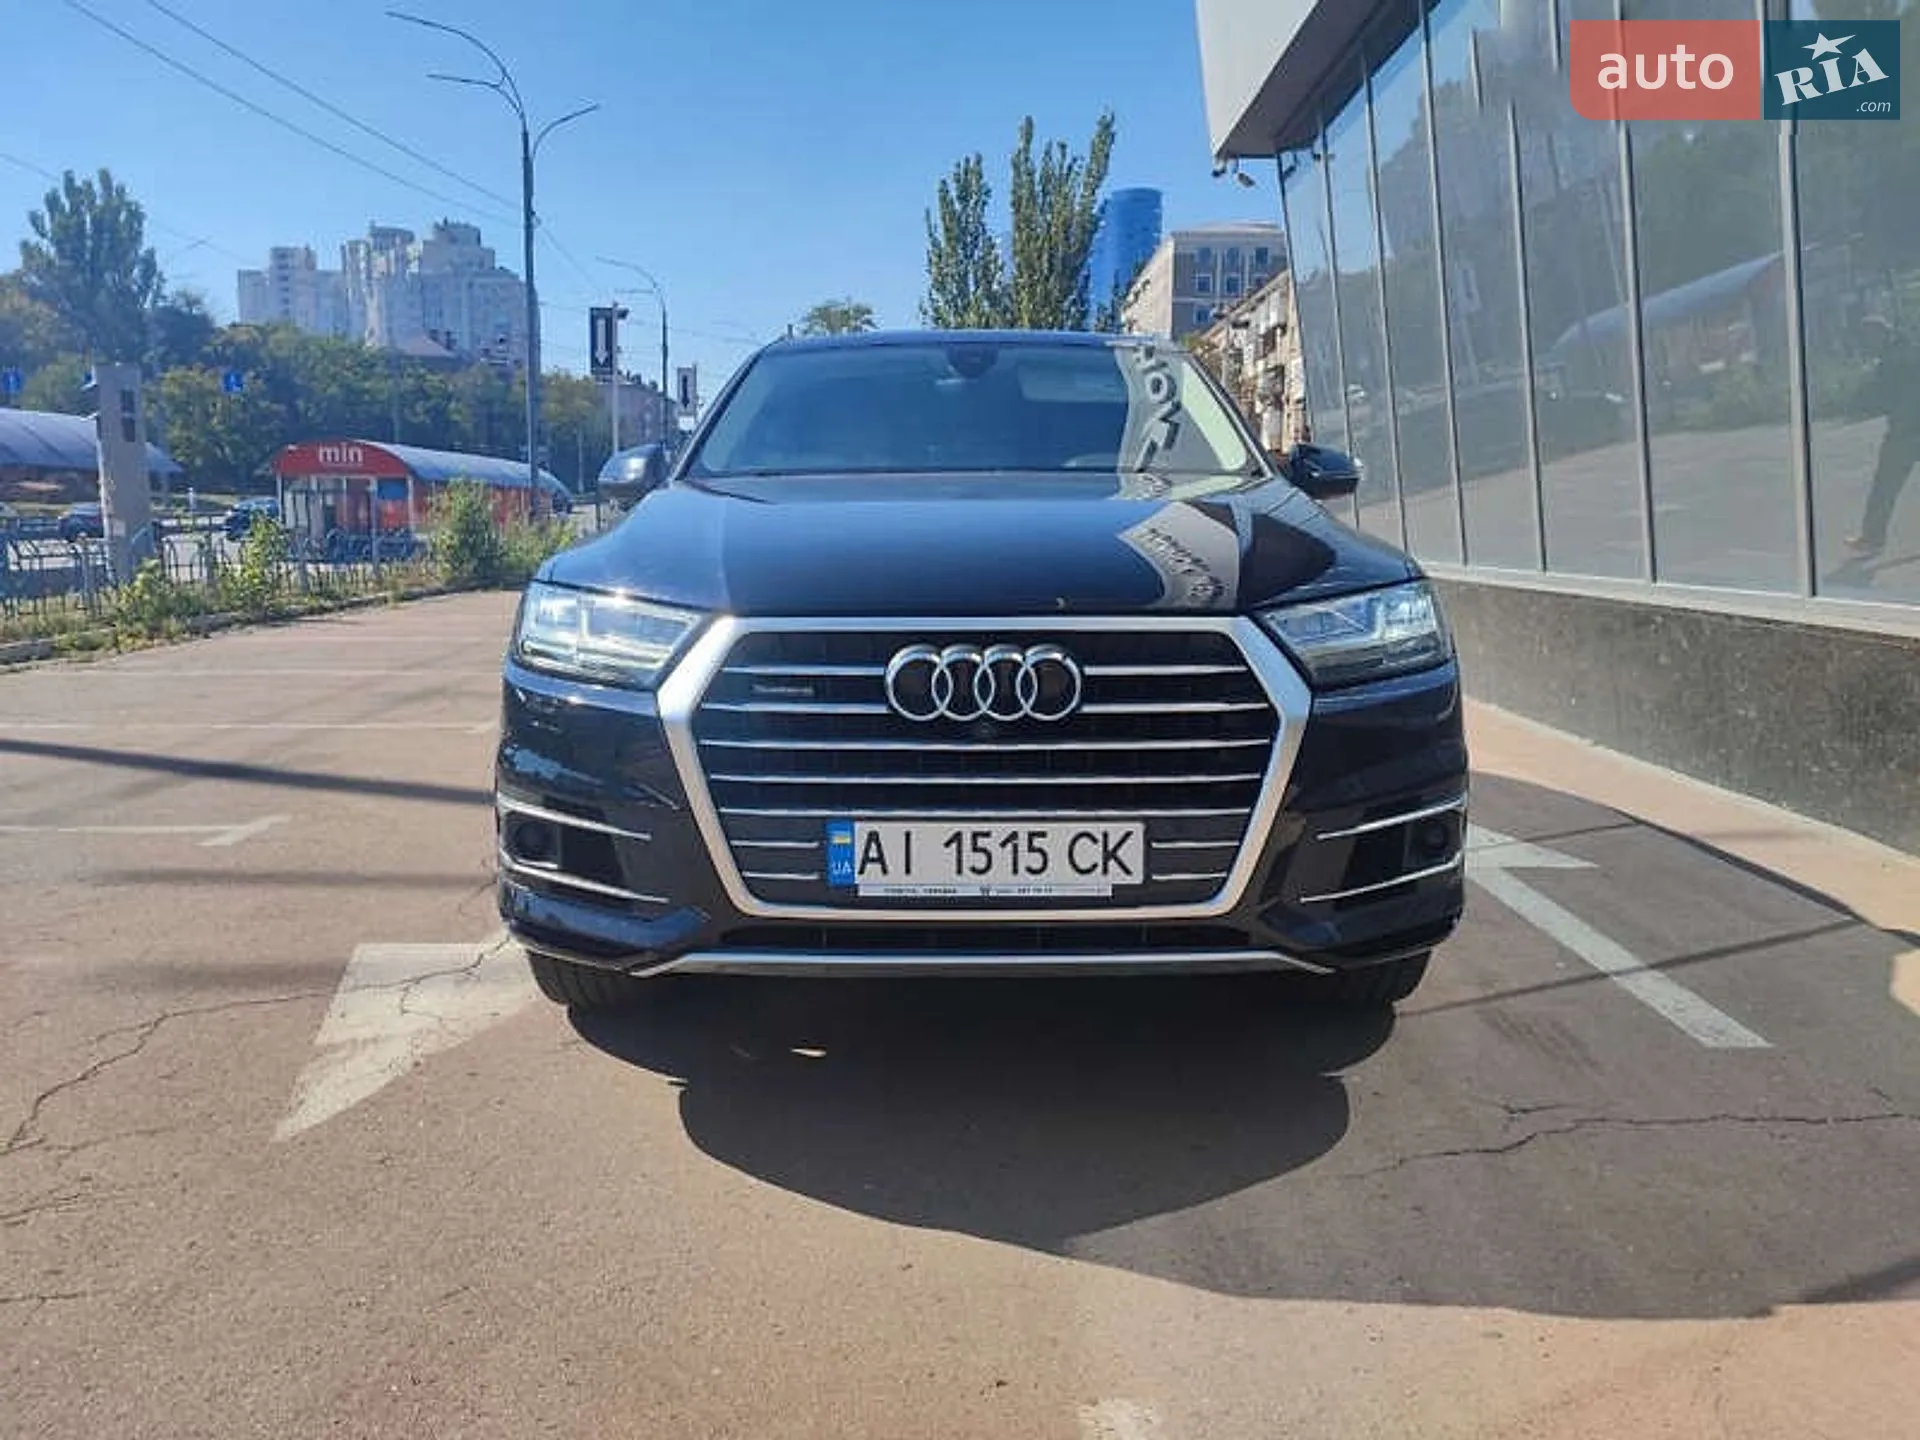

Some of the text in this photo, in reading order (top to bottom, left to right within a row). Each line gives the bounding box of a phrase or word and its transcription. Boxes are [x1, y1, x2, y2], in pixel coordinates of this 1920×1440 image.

[319, 442, 363, 462] min
[858, 830, 1135, 876] AI 1515 CK
[832, 860, 852, 875] UA
